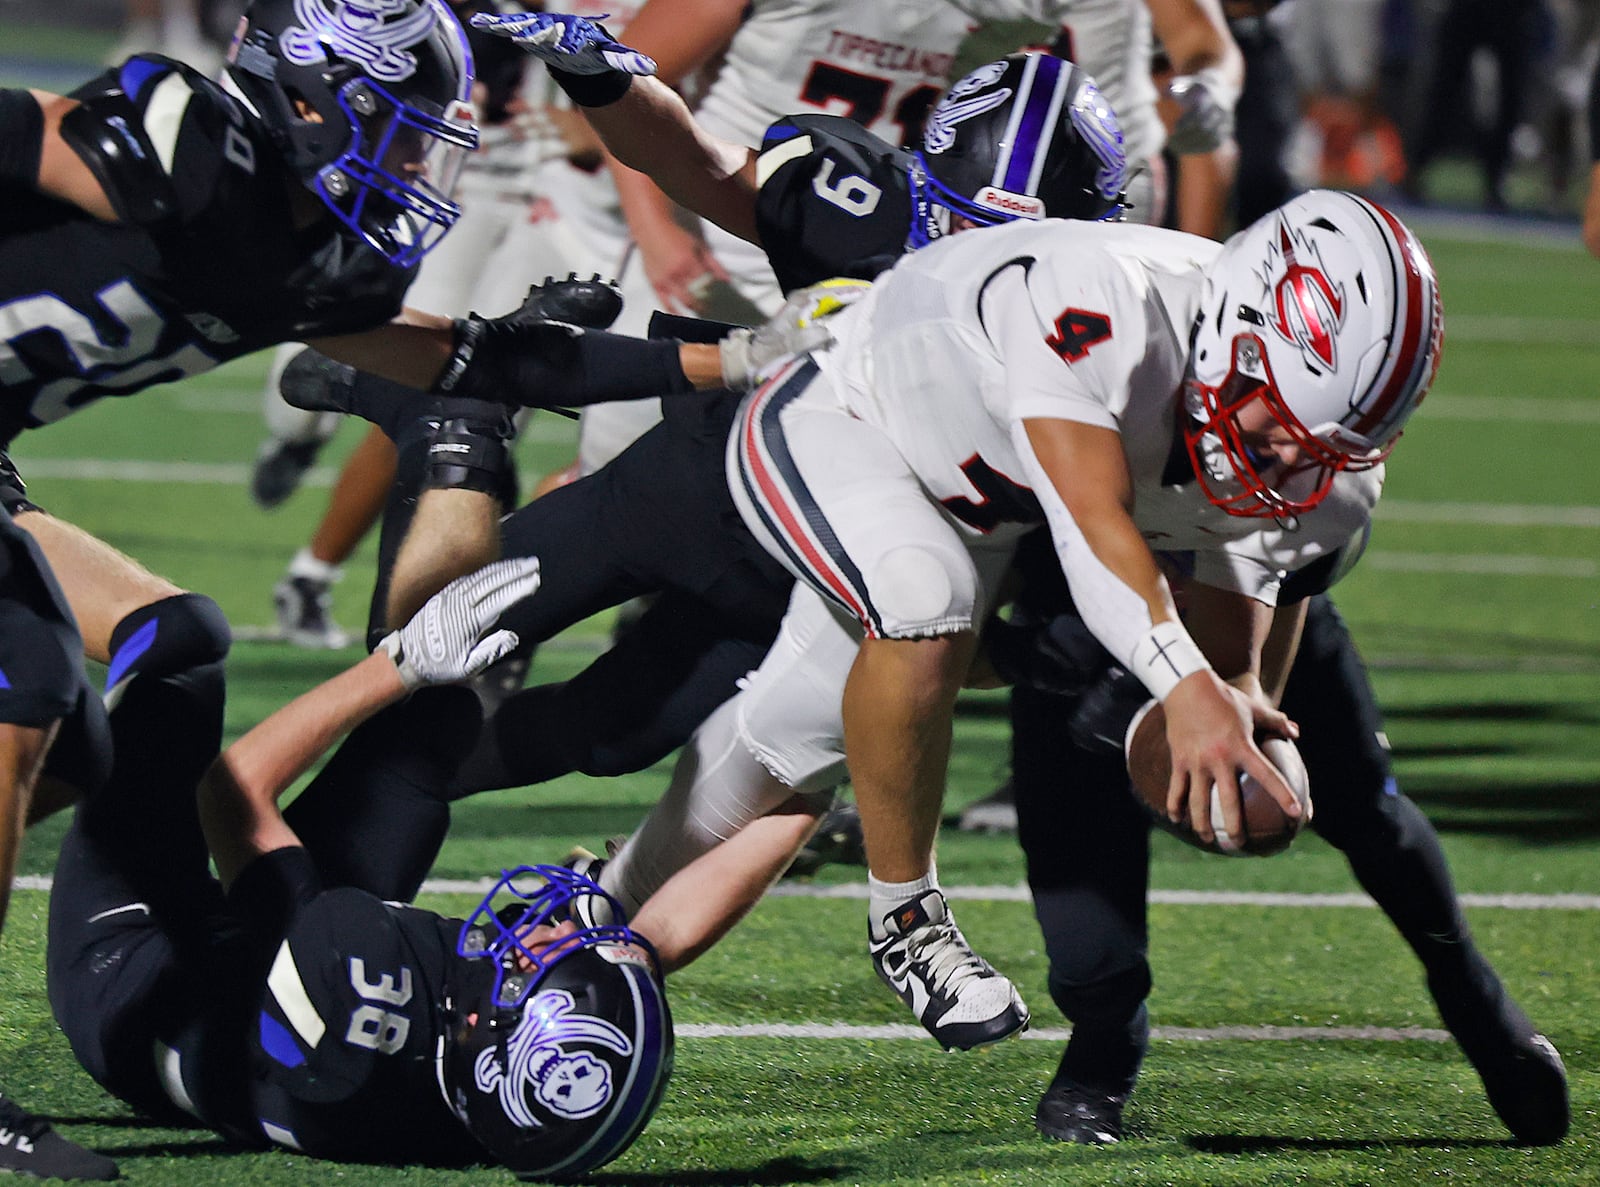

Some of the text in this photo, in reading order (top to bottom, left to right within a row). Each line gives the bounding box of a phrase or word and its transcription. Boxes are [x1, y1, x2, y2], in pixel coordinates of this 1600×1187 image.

[827, 29, 956, 77] TIPPECANO
[810, 155, 883, 217] 9
[986, 191, 1039, 215] Riddell
[1044, 306, 1112, 364] 4
[345, 956, 413, 1055] 38
